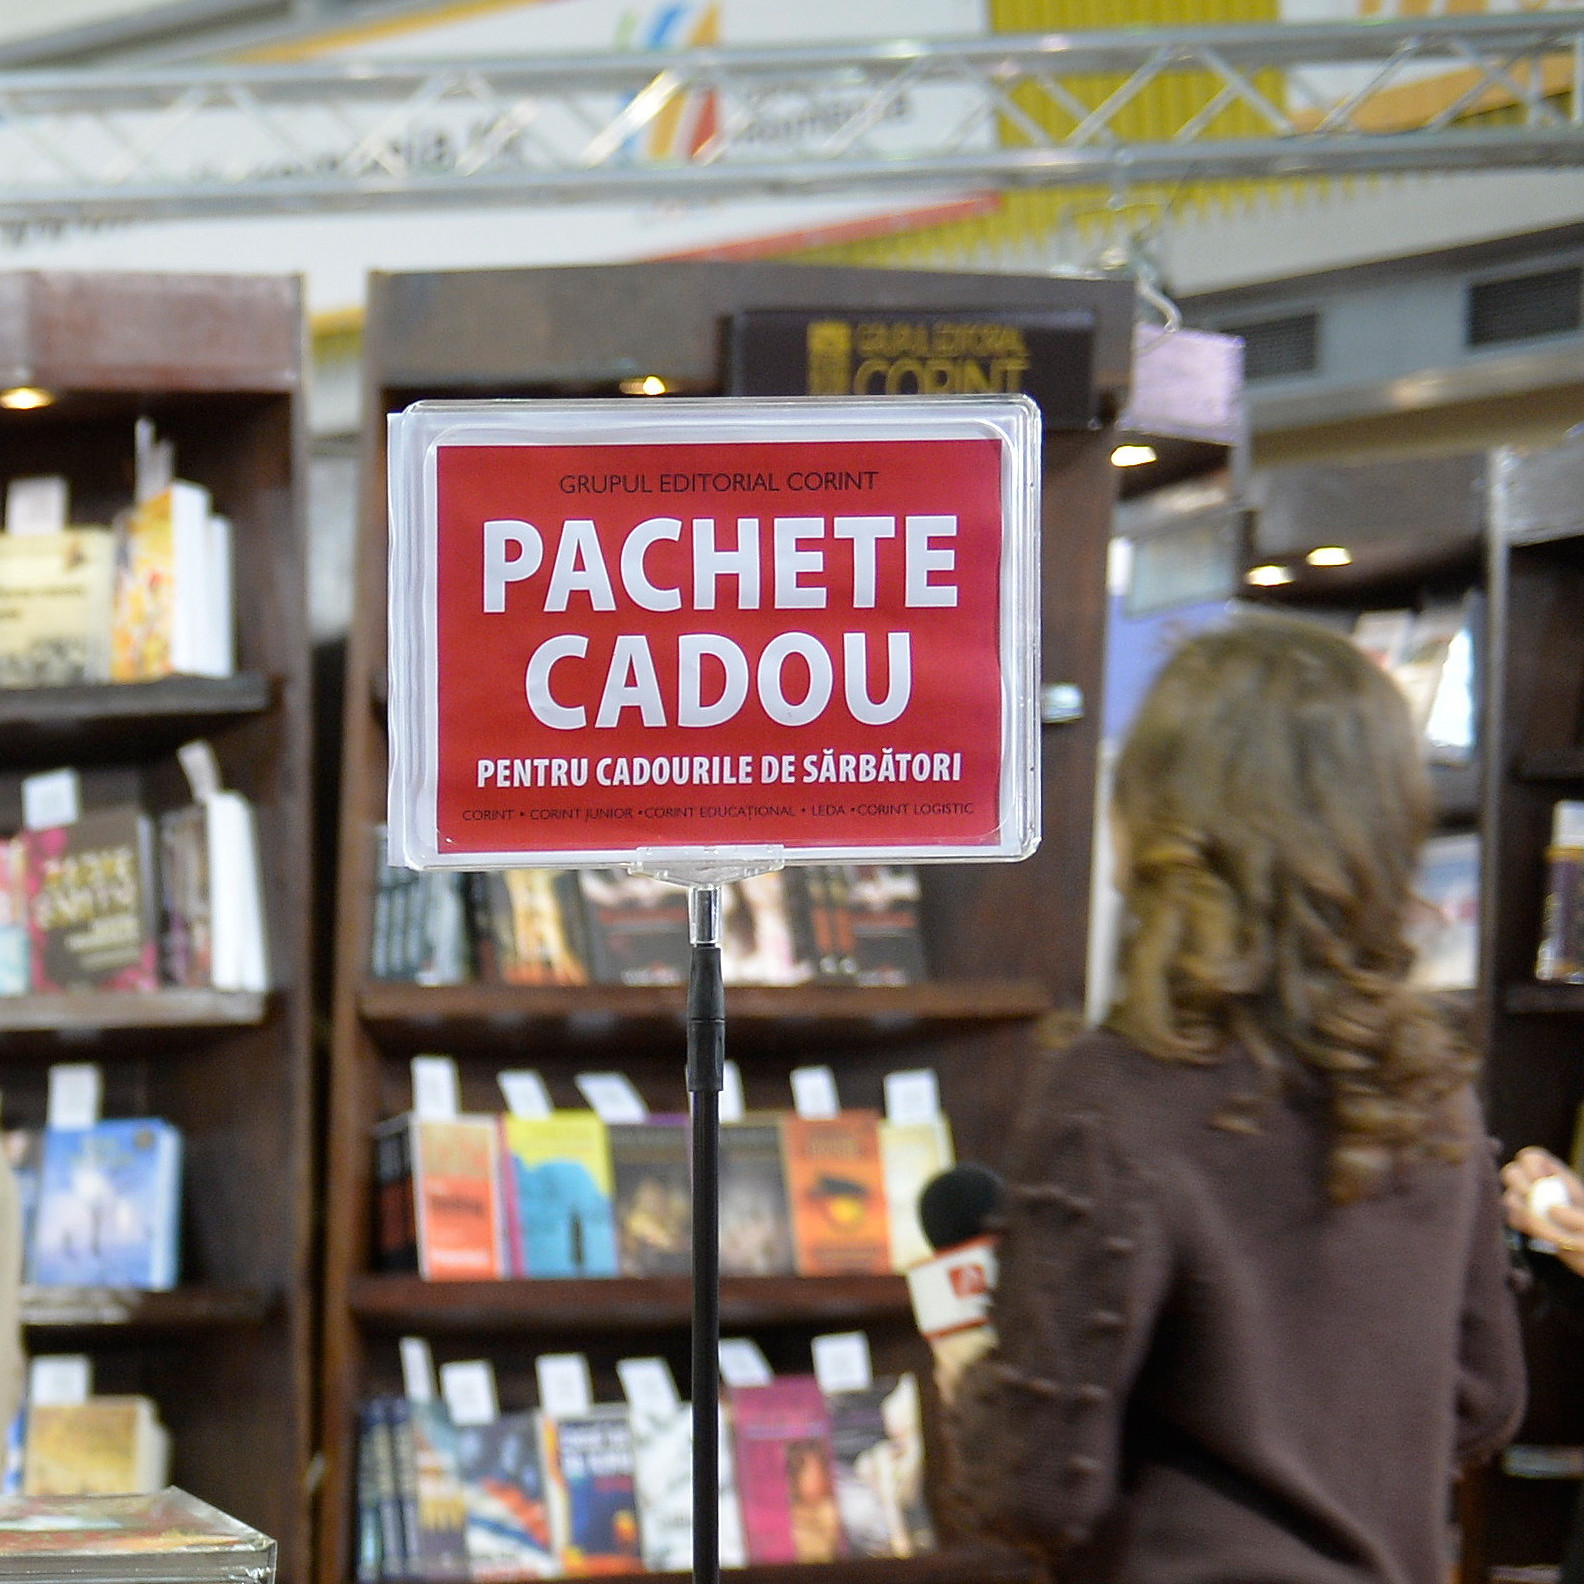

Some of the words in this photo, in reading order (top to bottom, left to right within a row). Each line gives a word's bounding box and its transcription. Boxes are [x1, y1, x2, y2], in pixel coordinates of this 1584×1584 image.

[560, 473, 653, 494] GRUPUL
[660, 472, 780, 493] EDITORIAL
[788, 470, 878, 492] CORINT
[483, 515, 959, 614] PACHETE
[526, 631, 912, 730] CADOU
[477, 758, 589, 789] PENTRU
[595, 755, 753, 786] CADOURILE
[761, 754, 796, 784] DE
[802, 746, 962, 785] SĂRBĂTORI
[462, 809, 515, 821] CORINT
[529, 808, 583, 820] CORINT
[585, 808, 634, 822] JUNIOR
[644, 806, 696, 819] CORINT
[811, 804, 846, 817] LEDA
[858, 803, 910, 816] CORINT
[913, 802, 975, 816] LOGISTIC
